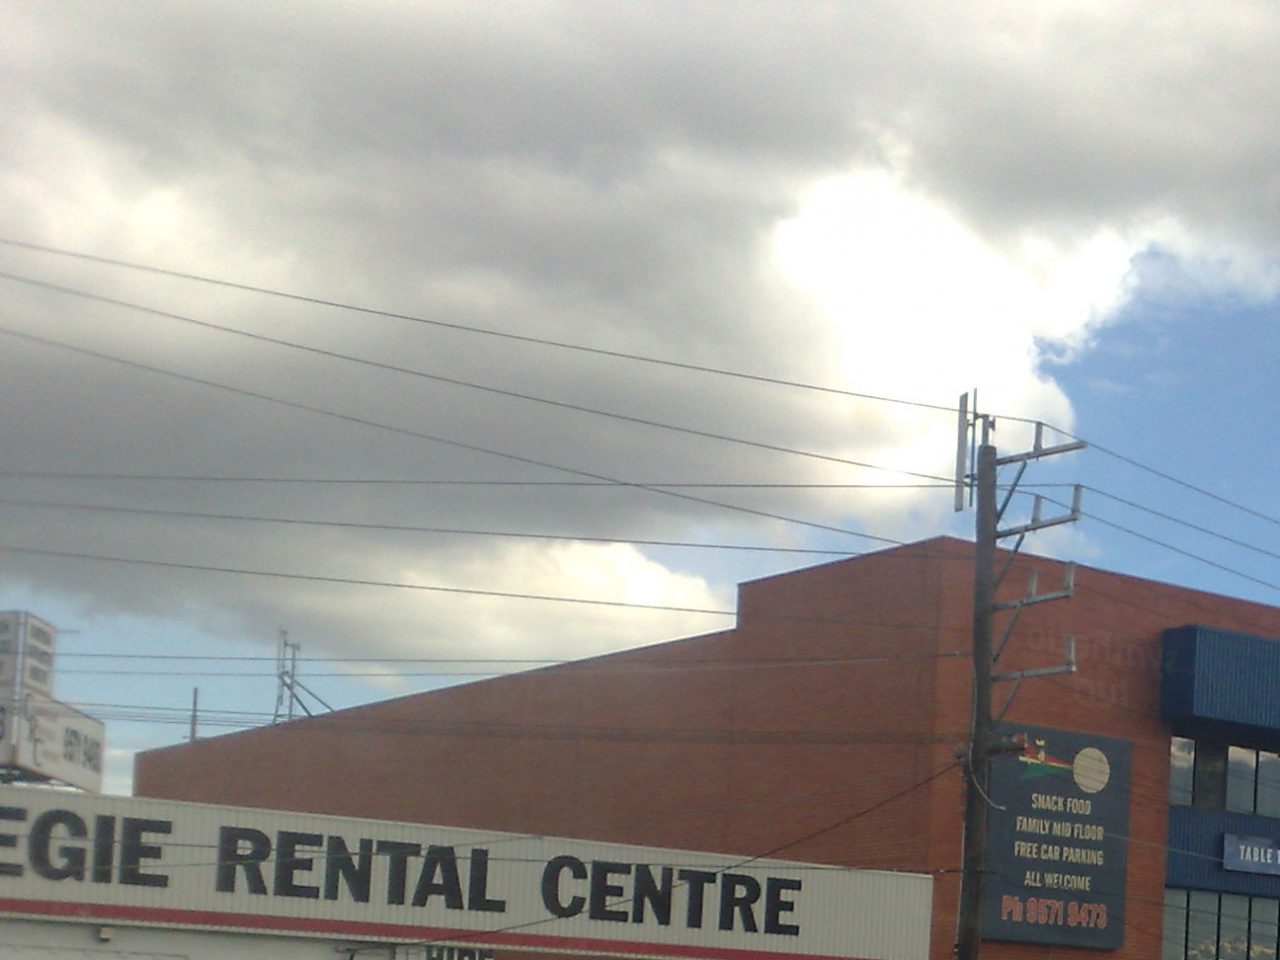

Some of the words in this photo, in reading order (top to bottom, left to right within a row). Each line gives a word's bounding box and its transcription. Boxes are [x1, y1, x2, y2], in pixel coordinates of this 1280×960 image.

[1031, 793, 1065, 812] SNACK
[1067, 797, 1092, 815] FOOD
[1016, 816, 1050, 835] FAMILY
[1052, 820, 1071, 837] MID
[1073, 823, 1104, 841] FLOOR
[1014, 841, 1038, 858] FREE
[1041, 844, 1061, 861] CAR
[1062, 846, 1104, 866] PARKING
[1240, 845, 1273, 864] TABLE
[216, 826, 506, 912] RENTAL
[541, 855, 802, 936] CENTRE
[1024, 870, 1042, 888] ALL
[1044, 873, 1091, 891] WELCOME
[1002, 895, 1023, 922] Ph
